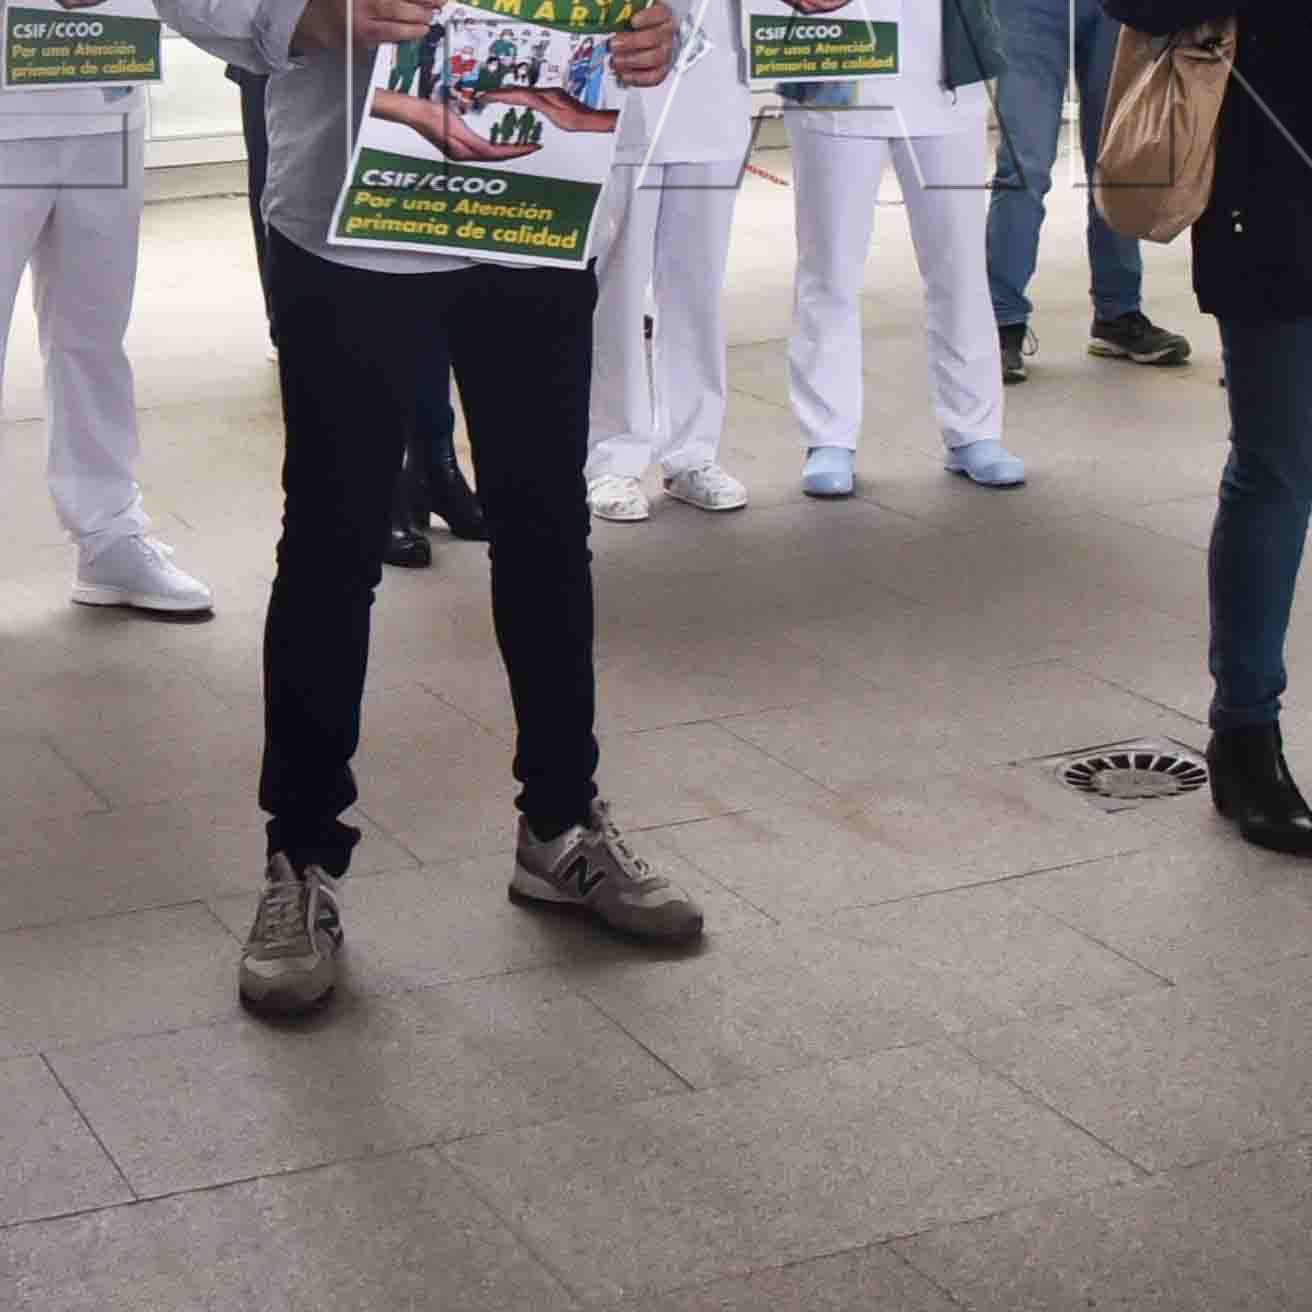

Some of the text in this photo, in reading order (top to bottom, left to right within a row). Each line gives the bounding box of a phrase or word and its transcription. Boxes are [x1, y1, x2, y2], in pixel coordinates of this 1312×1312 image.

[12, 21, 104, 39] CSIF/CCOO
[755, 25, 842, 40] CSIF/CCOO
[362, 169, 508, 195] CSIF/CCOO
[353, 191, 554, 221] Por una Atención
[345, 213, 578, 249] primaria de calidad
